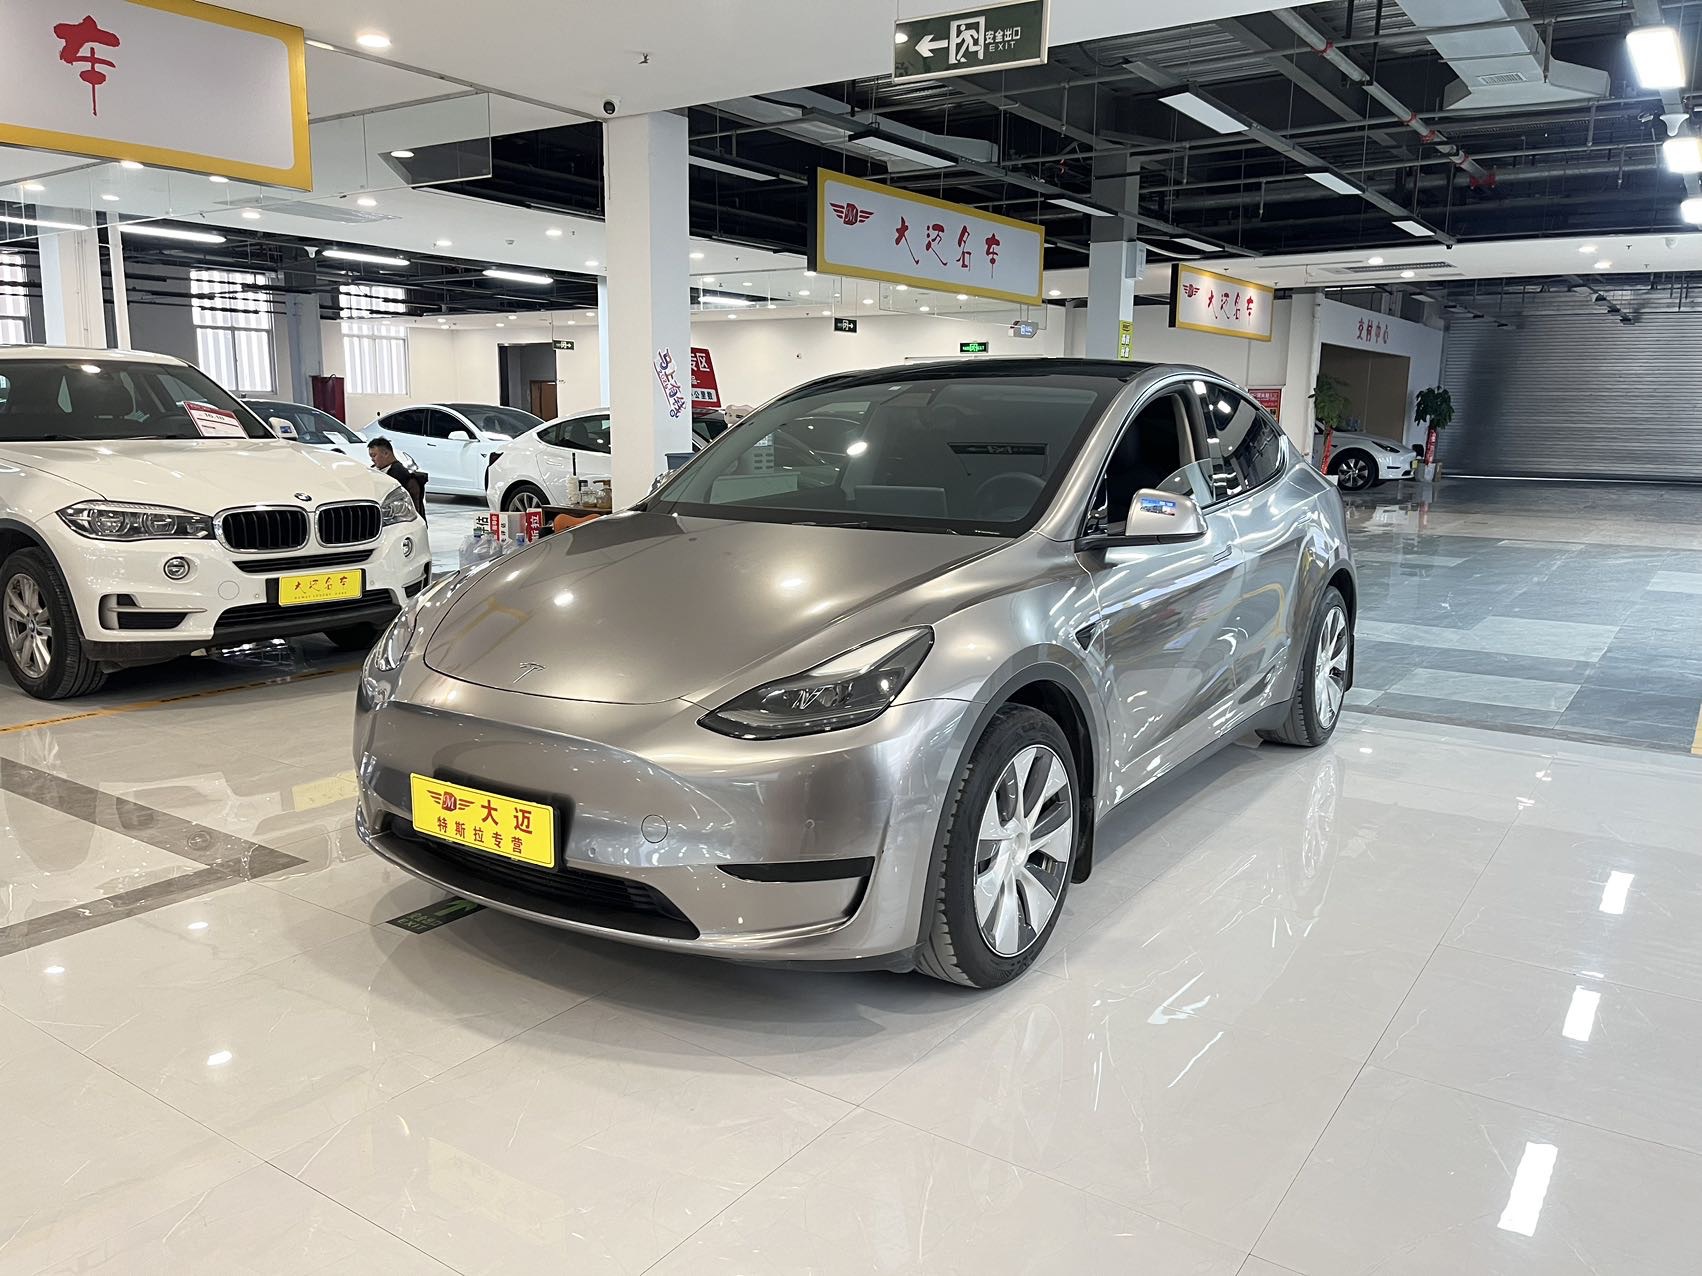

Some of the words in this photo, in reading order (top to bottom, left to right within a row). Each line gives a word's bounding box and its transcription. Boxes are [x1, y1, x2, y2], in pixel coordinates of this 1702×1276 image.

[985, 27, 1021, 43] 安全出口
[989, 41, 1016, 52] EXIT
[895, 216, 1001, 279] 大迈名车
[1207, 289, 1254, 325] 大迈名车
[691, 390, 714, 400] 公里数
[294, 576, 348, 595] 大迈名车
[480, 800, 533, 834] 大迈
[437, 816, 523, 854] 特斯拉专营
